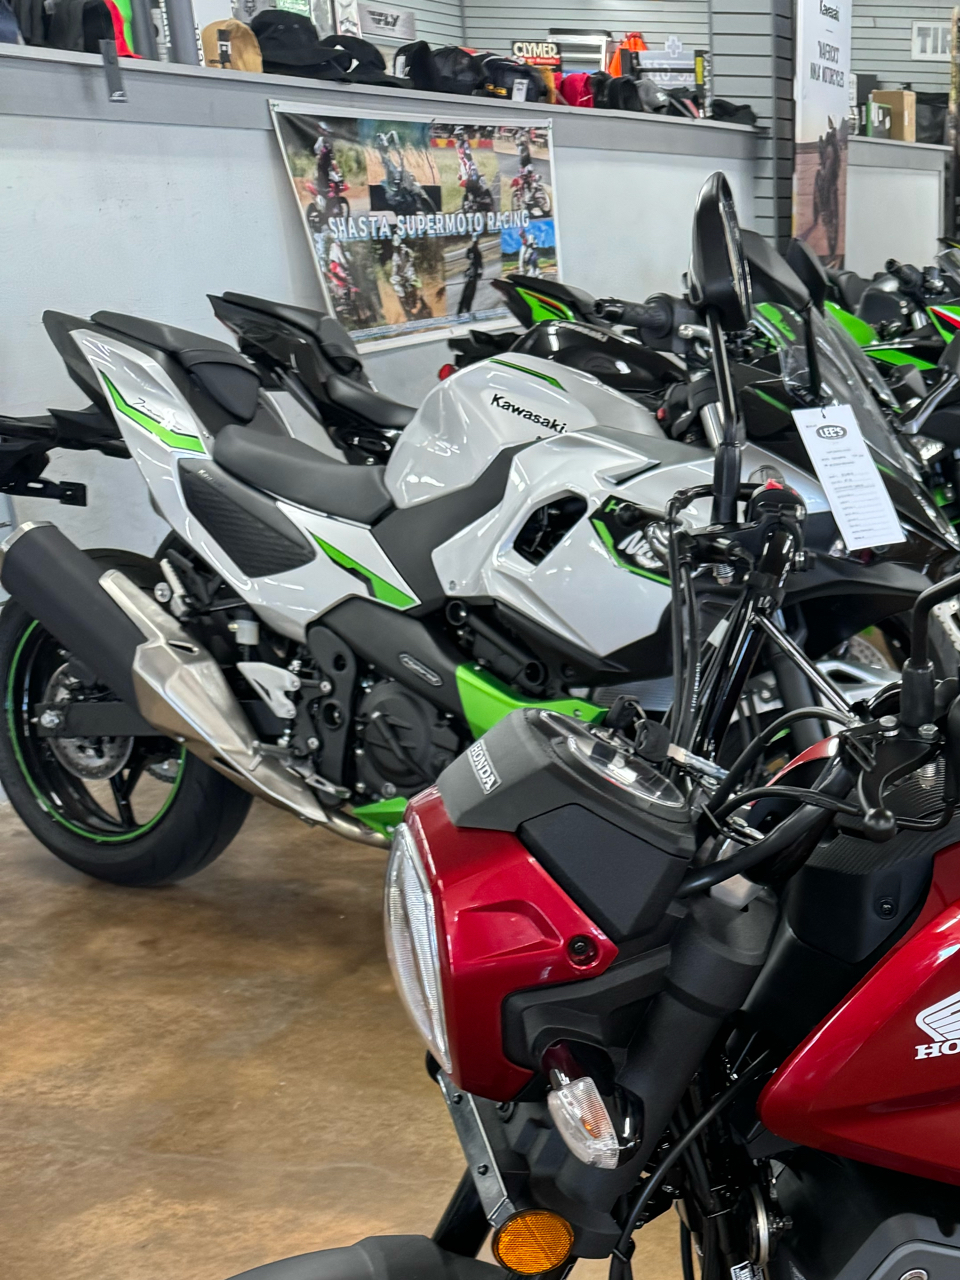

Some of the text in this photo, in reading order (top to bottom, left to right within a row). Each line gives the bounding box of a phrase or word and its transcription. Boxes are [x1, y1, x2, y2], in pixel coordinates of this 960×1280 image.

[513, 41, 560, 58] CLYMER
[917, 26, 951, 54] TIR
[328, 209, 530, 239] SHASTA SUPERMOTO RACING
[491, 394, 566, 434] Kawasaki
[819, 426, 844, 437] LEE'S
[471, 743, 495, 790] HONDA
